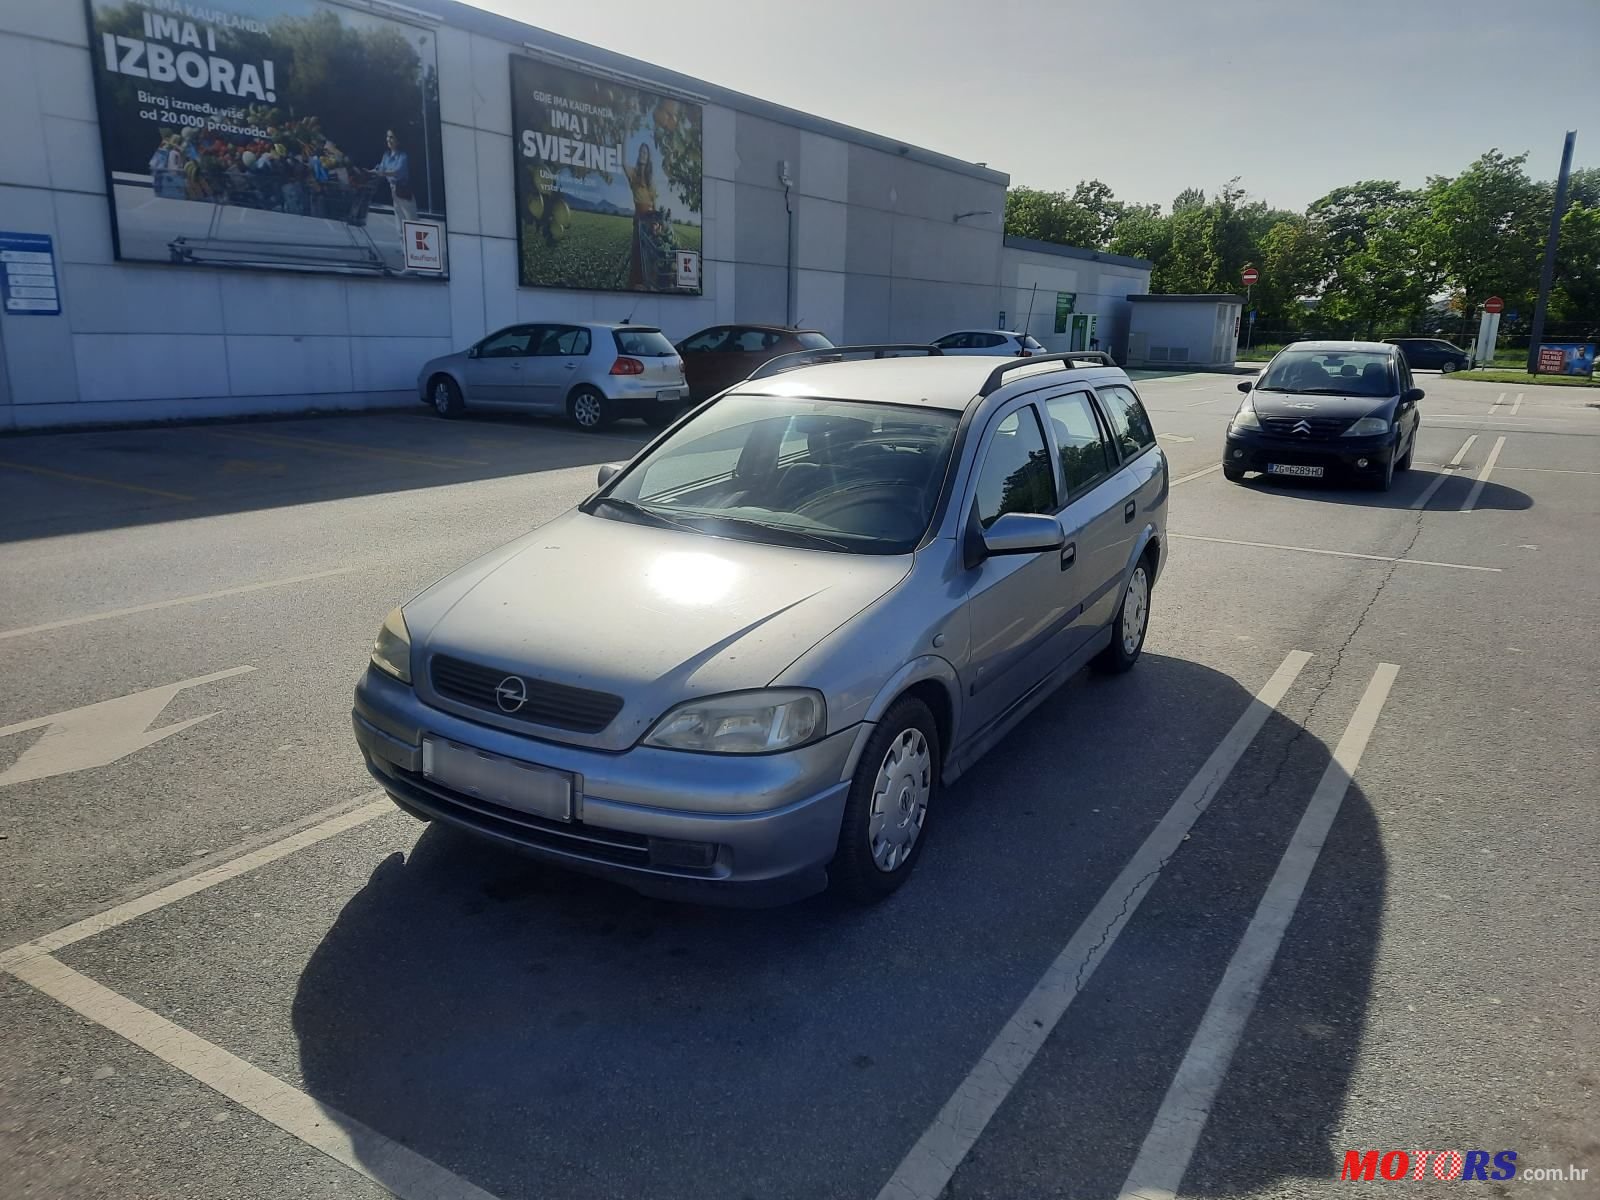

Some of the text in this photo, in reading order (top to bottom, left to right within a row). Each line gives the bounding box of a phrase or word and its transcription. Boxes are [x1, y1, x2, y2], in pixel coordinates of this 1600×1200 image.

[142, 11, 217, 52] IMA I
[102, 31, 277, 103] IZBORA!
[137, 90, 169, 107] Biraj
[171, 97, 218, 116] između
[553, 96, 569, 109] IMA
[139, 109, 158, 121] od
[160, 110, 205, 128] 20.000
[551, 109, 581, 133] IMA
[1274, 464, 1285, 474] ZG
